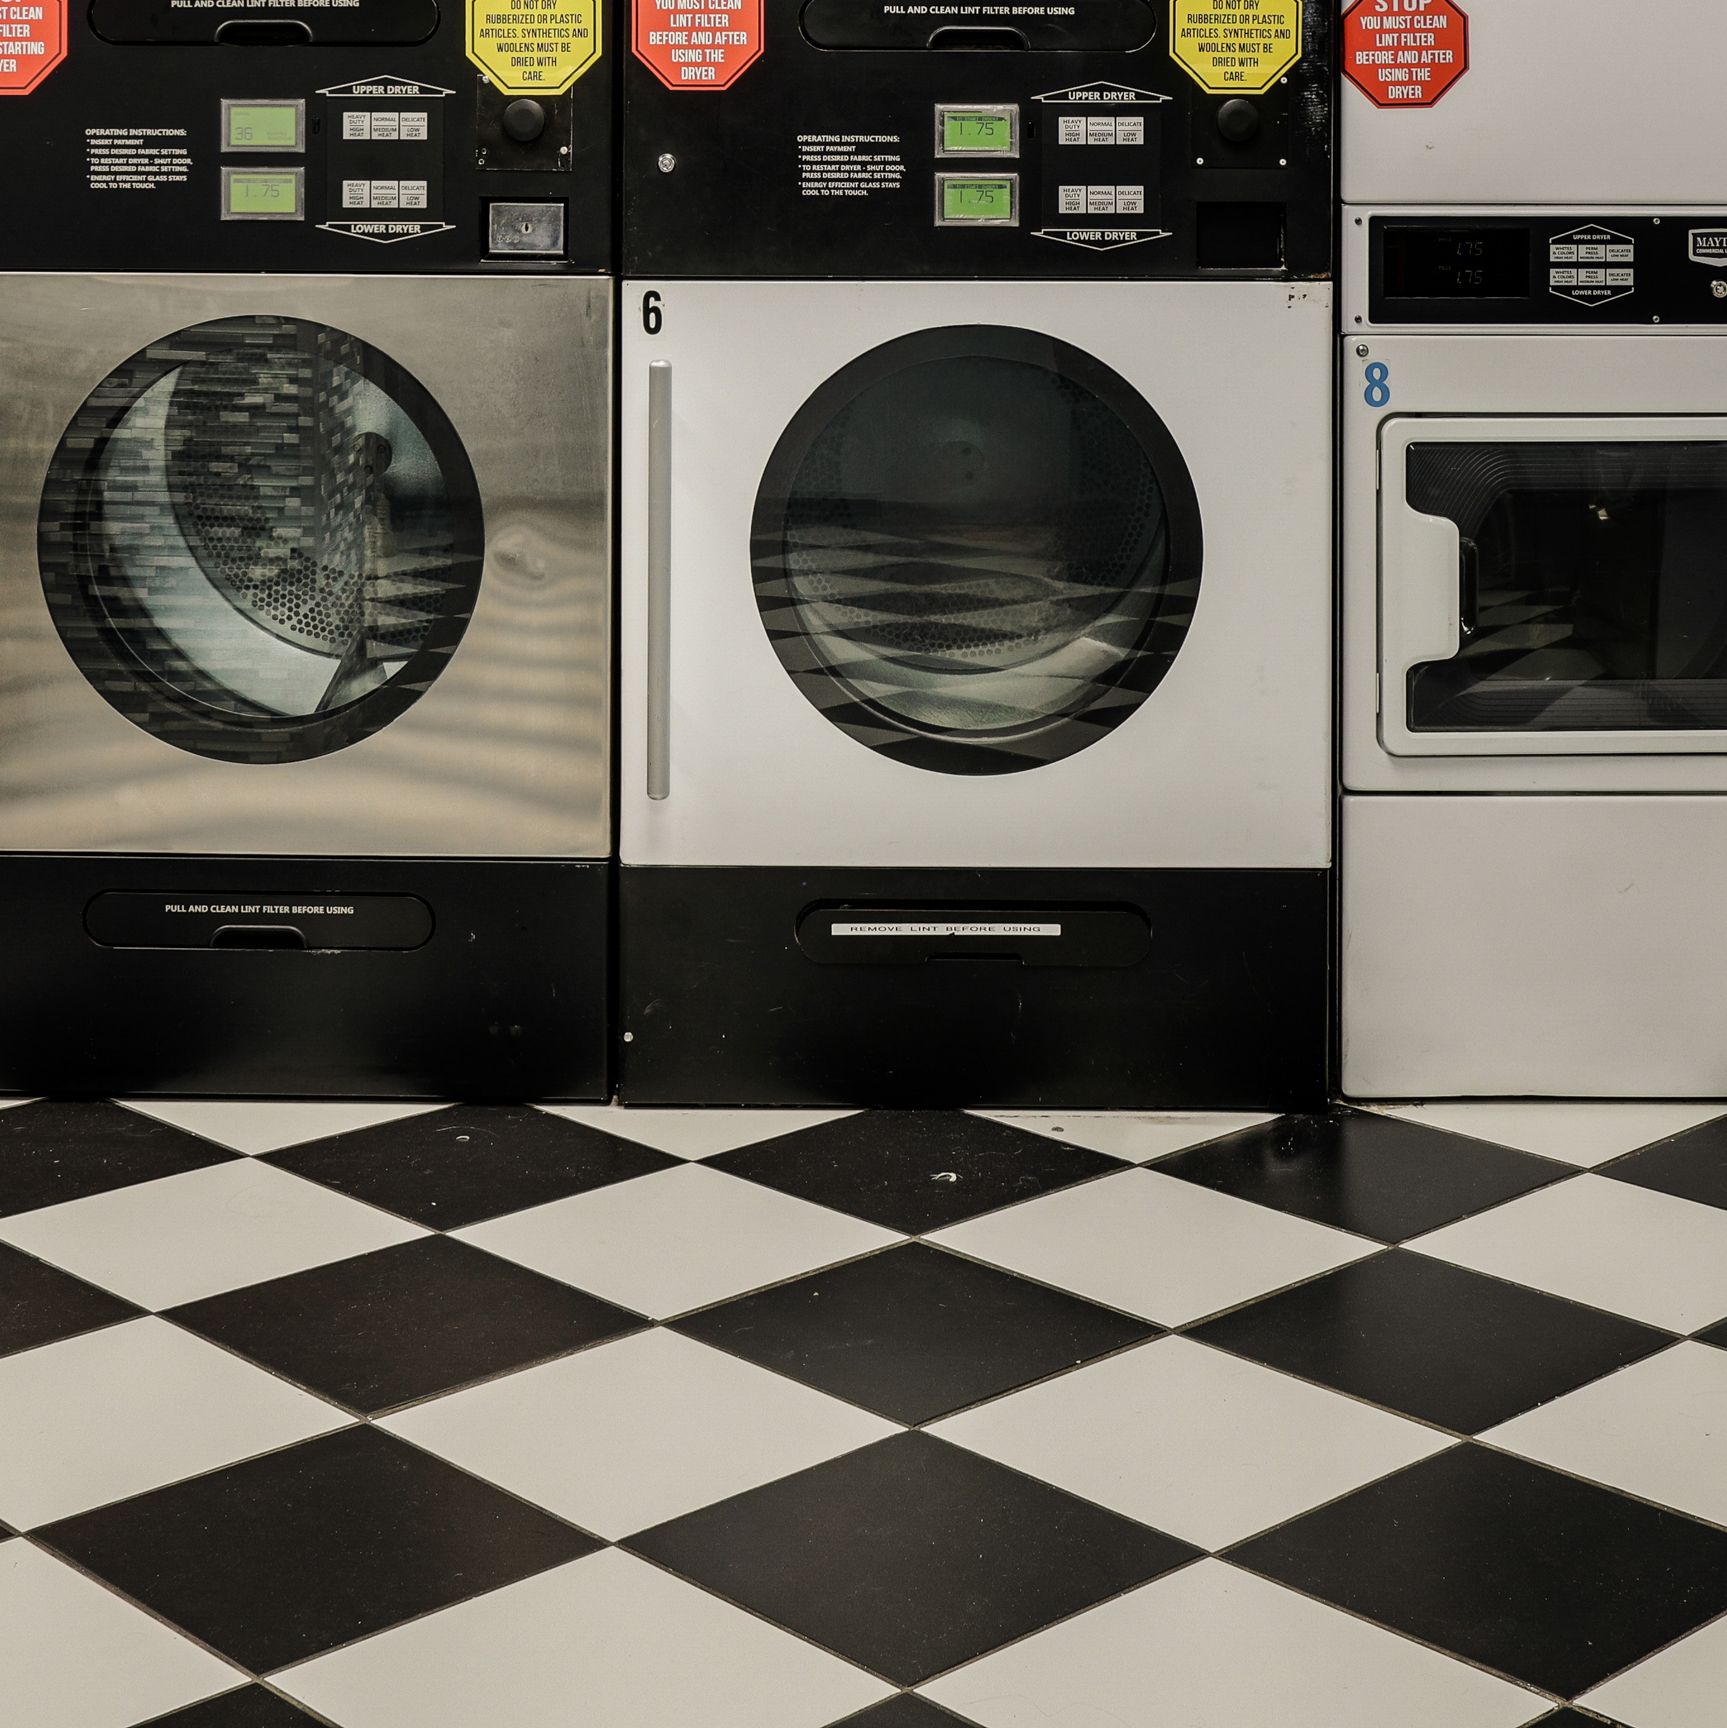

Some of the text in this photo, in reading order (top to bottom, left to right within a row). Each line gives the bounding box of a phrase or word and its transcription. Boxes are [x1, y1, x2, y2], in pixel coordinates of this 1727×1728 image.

[10, 6, 44, 21] CLEAN
[883, 5, 1076, 16] PULL AND CLEAN LINT FILTER BEFORE USING
[1359, 15, 1448, 30] YOU MUST CLEAN
[1376, 32, 1435, 47] LINT FILTER
[1355, 49, 1454, 65] BEFORE AND AFTER
[1378, 67, 1432, 82] USING THE
[1067, 91, 1137, 101] UPPER DRYER
[1388, 85, 1423, 100] DRYER
[234, 126, 254, 141] 36
[959, 122, 995, 136] 1.75
[796, 134, 901, 143] OPERATING INSTRUCTIONS:
[959, 190, 995, 204] 1.75
[1066, 231, 1138, 241] LOWER DRYER
[642, 290, 663, 336] 6
[1362, 359, 1391, 408] 8
[850, 925, 1041, 933] REMOVE LINT BEFORE USING
